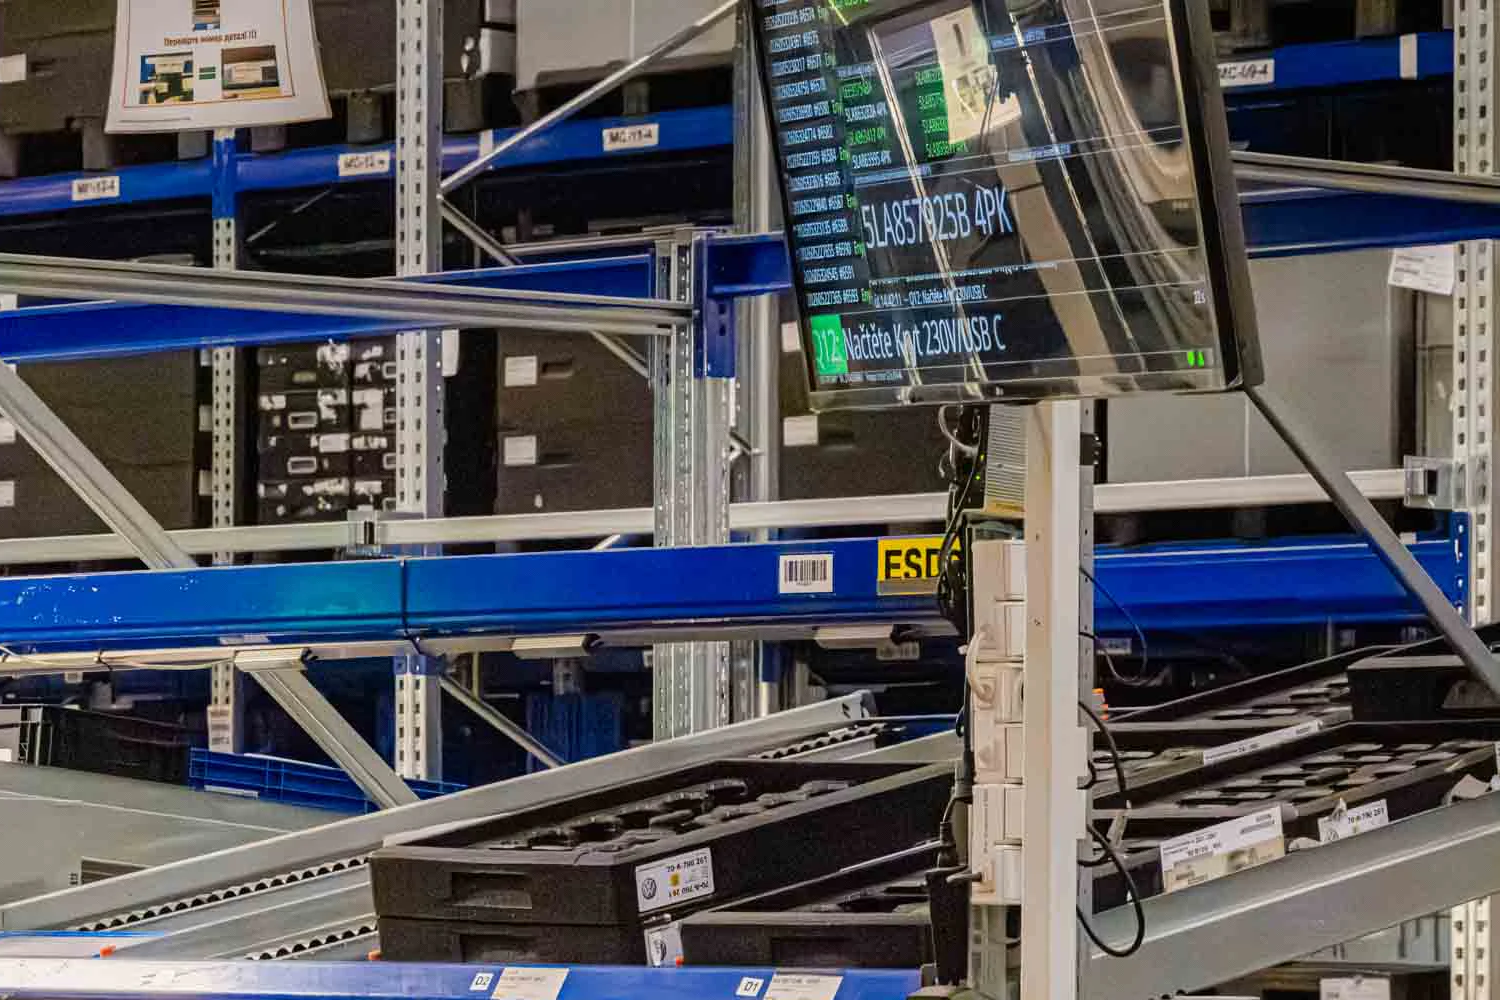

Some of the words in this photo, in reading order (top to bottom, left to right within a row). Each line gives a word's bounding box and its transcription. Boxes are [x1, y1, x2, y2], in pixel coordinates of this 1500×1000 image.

[861, 192, 971, 249] 5LA857925B
[975, 186, 1014, 235] 4PK
[845, 322, 893, 361] Načtěte
[923, 316, 993, 356] 230V/USB
[994, 314, 1007, 350] C
[743, 981, 758, 992] D1
